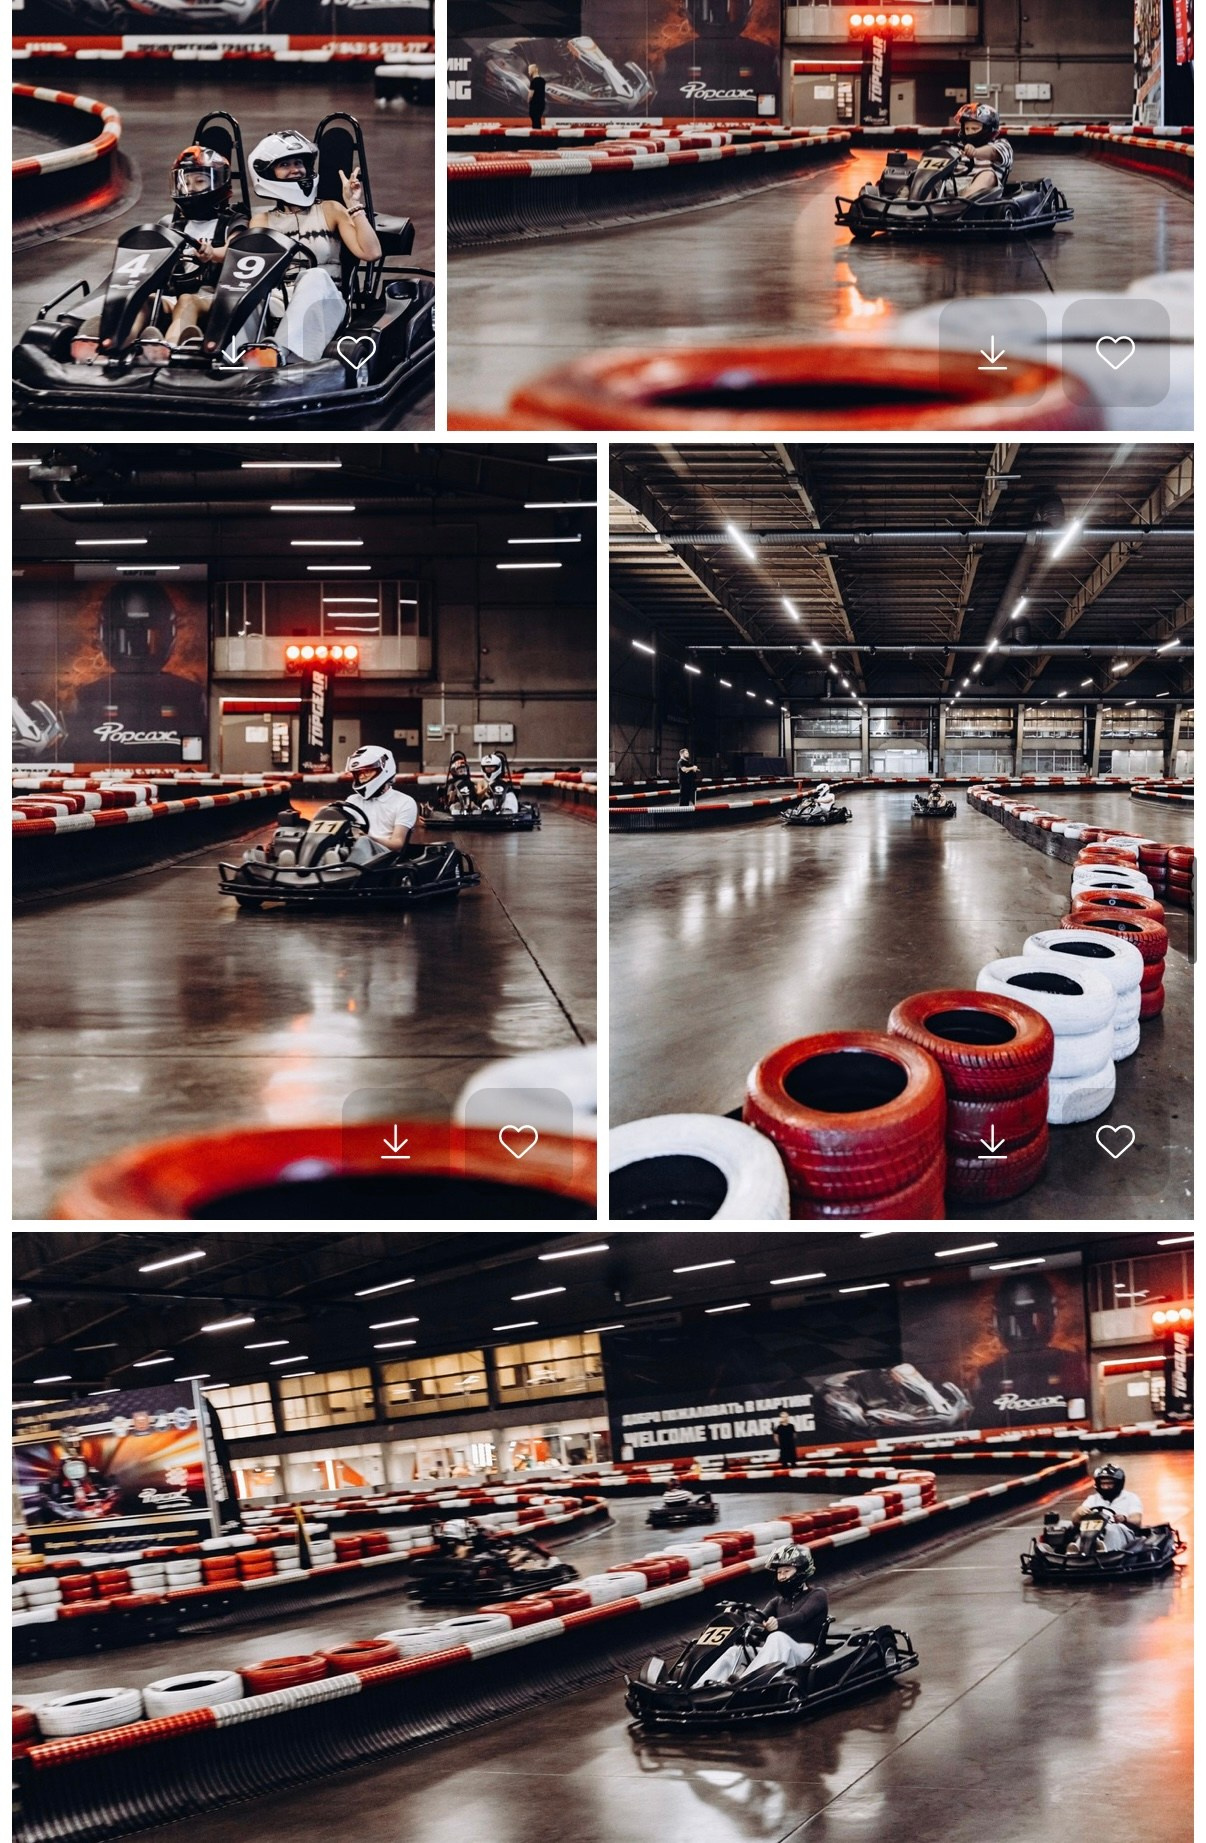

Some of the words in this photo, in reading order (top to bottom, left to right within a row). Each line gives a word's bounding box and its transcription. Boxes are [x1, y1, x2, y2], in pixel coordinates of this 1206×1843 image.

[922, 158, 946, 169] 14
[116, 253, 151, 279] 4
[232, 255, 266, 280] 9
[314, 821, 338, 833] 11
[622, 1425, 707, 1449] WELCOME
[708, 1422, 733, 1441] TO
[733, 1413, 816, 1439] KARTNG
[702, 1628, 732, 1643] 15
